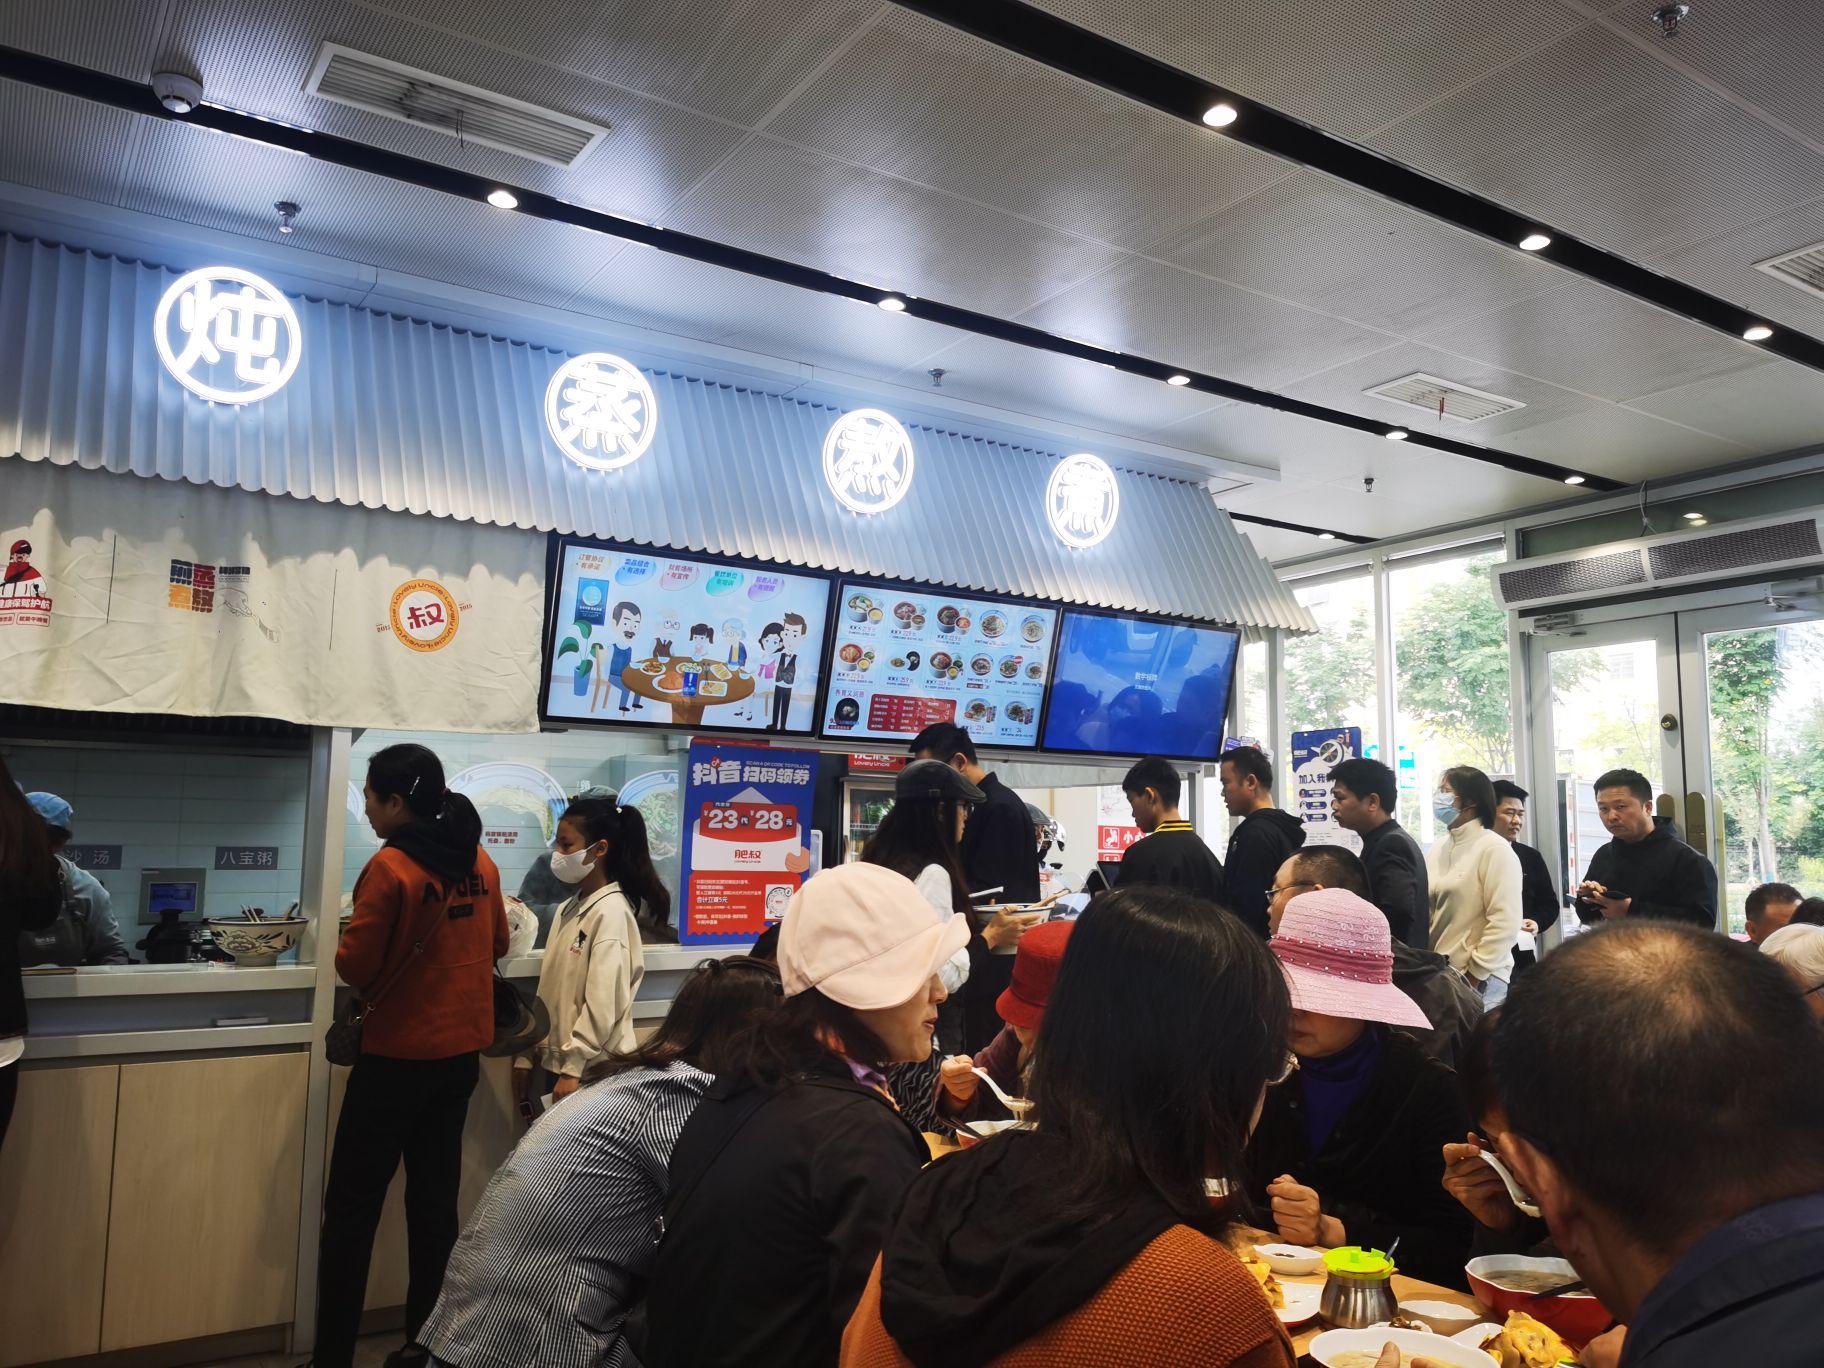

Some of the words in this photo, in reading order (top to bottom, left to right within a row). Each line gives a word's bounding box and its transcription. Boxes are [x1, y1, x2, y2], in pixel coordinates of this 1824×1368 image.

[175, 277, 291, 386] 炖
[559, 361, 645, 456] 蒸
[407, 602, 445, 630] 叔
[692, 760, 742, 786] 抖音
[743, 765, 810, 785] 扫码领券
[1298, 773, 1334, 784] 加入我
[220, 851, 273, 866] 八宝粥
[734, 849, 762, 859] 肥叔
